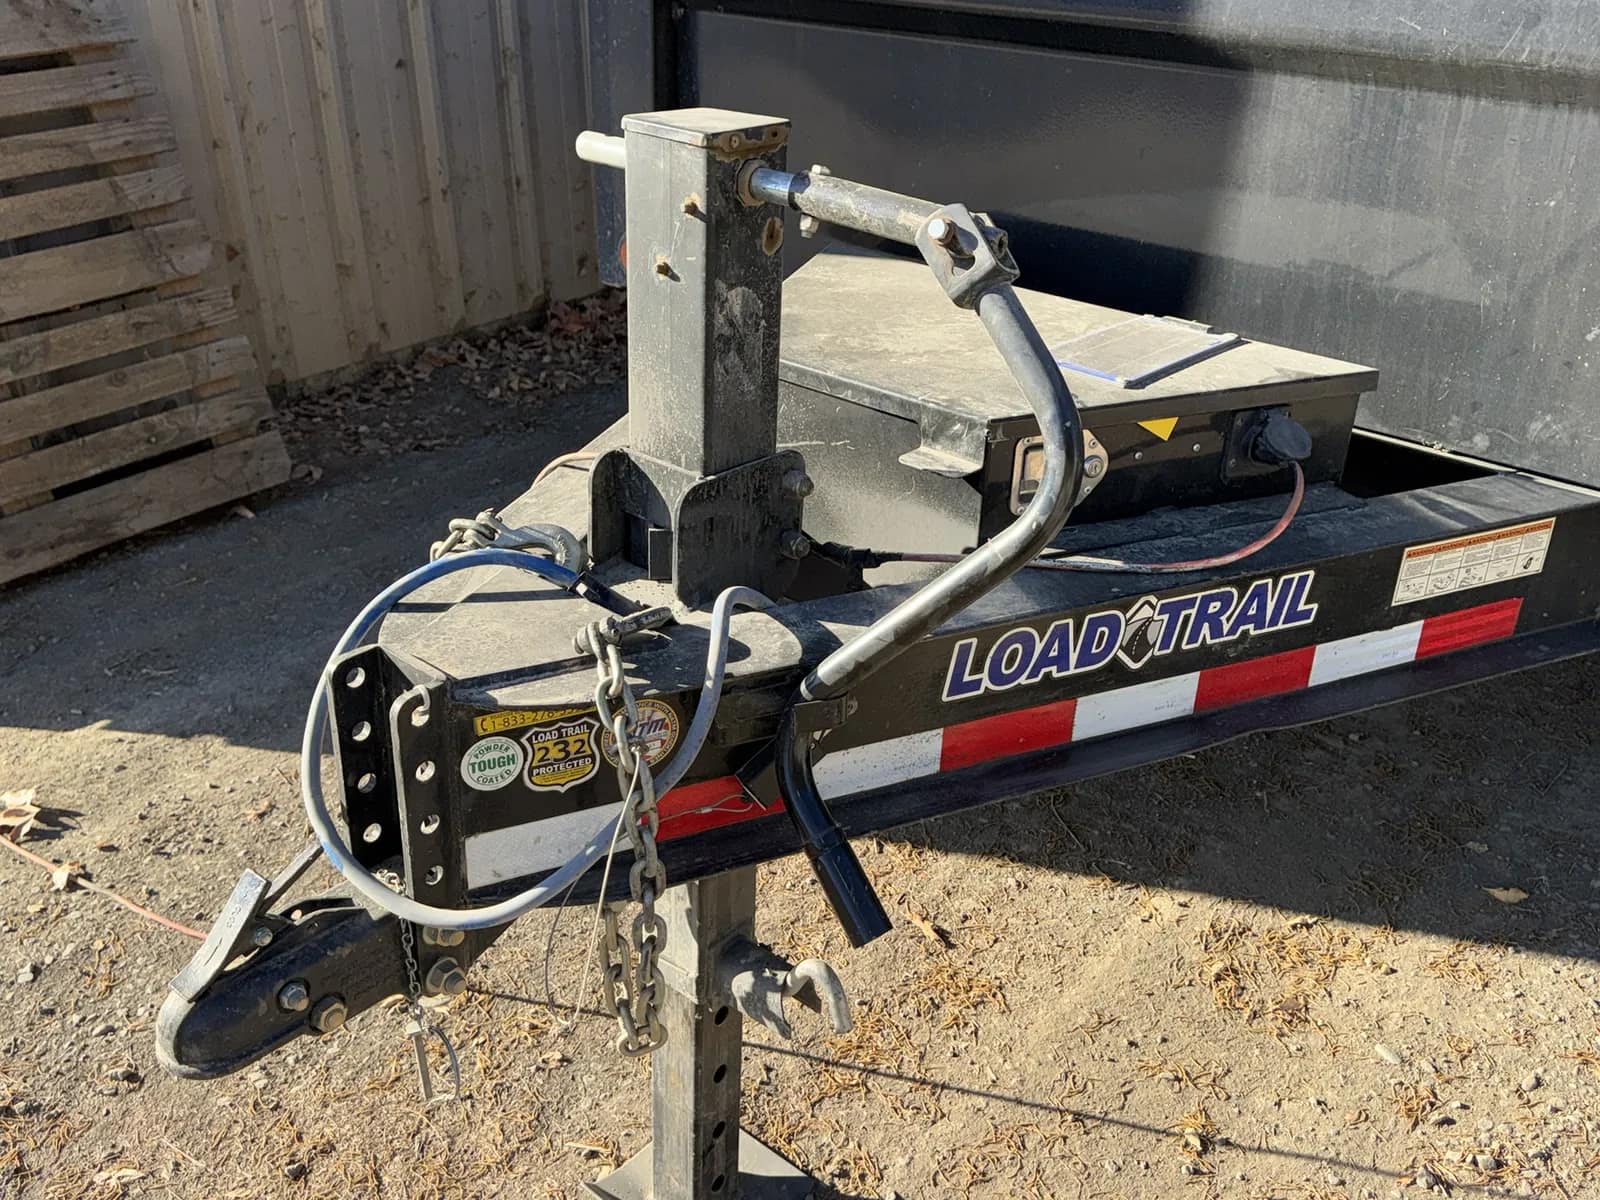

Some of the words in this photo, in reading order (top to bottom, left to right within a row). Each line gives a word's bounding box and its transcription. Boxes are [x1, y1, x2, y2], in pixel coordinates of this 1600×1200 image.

[942, 609, 1126, 703] LOAD
[1153, 570, 1320, 657] TRAIL
[531, 730, 558, 744] LOAD
[560, 724, 590, 737] TRAIL
[473, 742, 511, 760] POWDER
[536, 738, 587, 763] 232
[468, 753, 516, 774] TOUGH
[532, 756, 592, 777] PROTECTED
[475, 767, 513, 785] COATED
